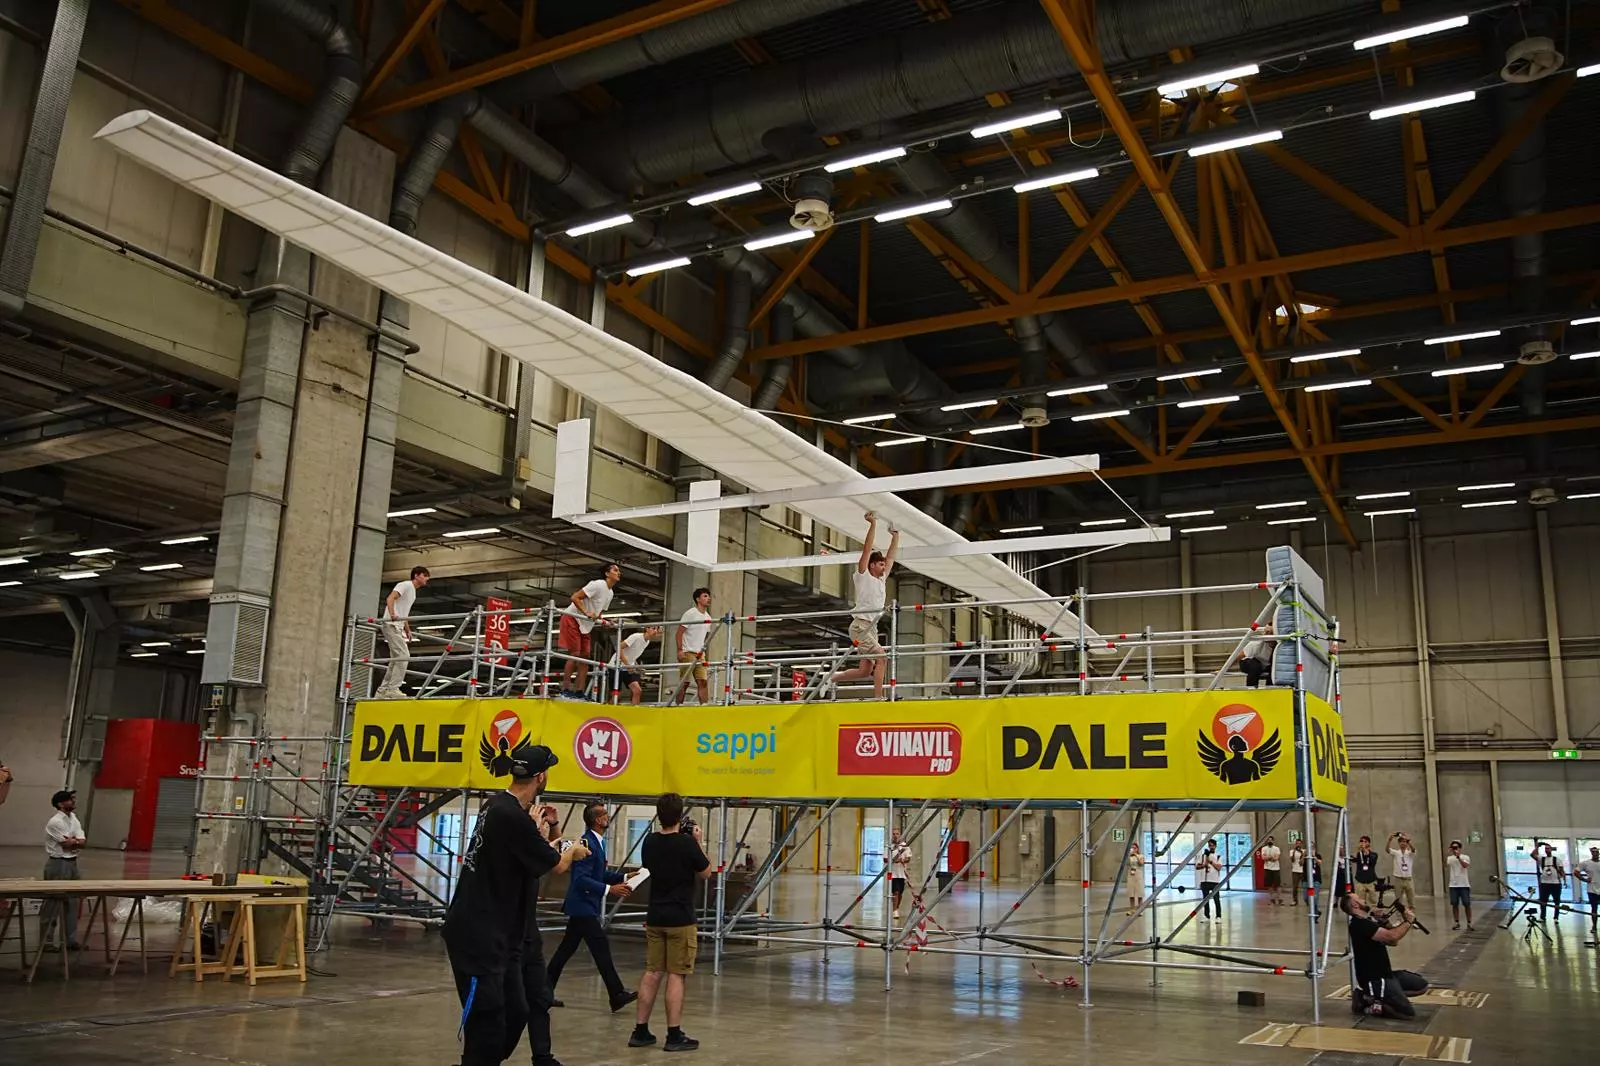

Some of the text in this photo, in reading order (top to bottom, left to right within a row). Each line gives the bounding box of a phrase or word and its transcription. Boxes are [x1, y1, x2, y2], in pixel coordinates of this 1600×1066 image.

[489, 614, 507, 632] 36
[360, 724, 466, 763] DALE
[696, 725, 776, 760] sappi
[881, 731, 953, 757] VINAVIL
[1002, 722, 1168, 770] DALE
[1311, 716, 1348, 786] DALE
[179, 764, 199, 776] Sna
[930, 758, 952, 772] PRO
